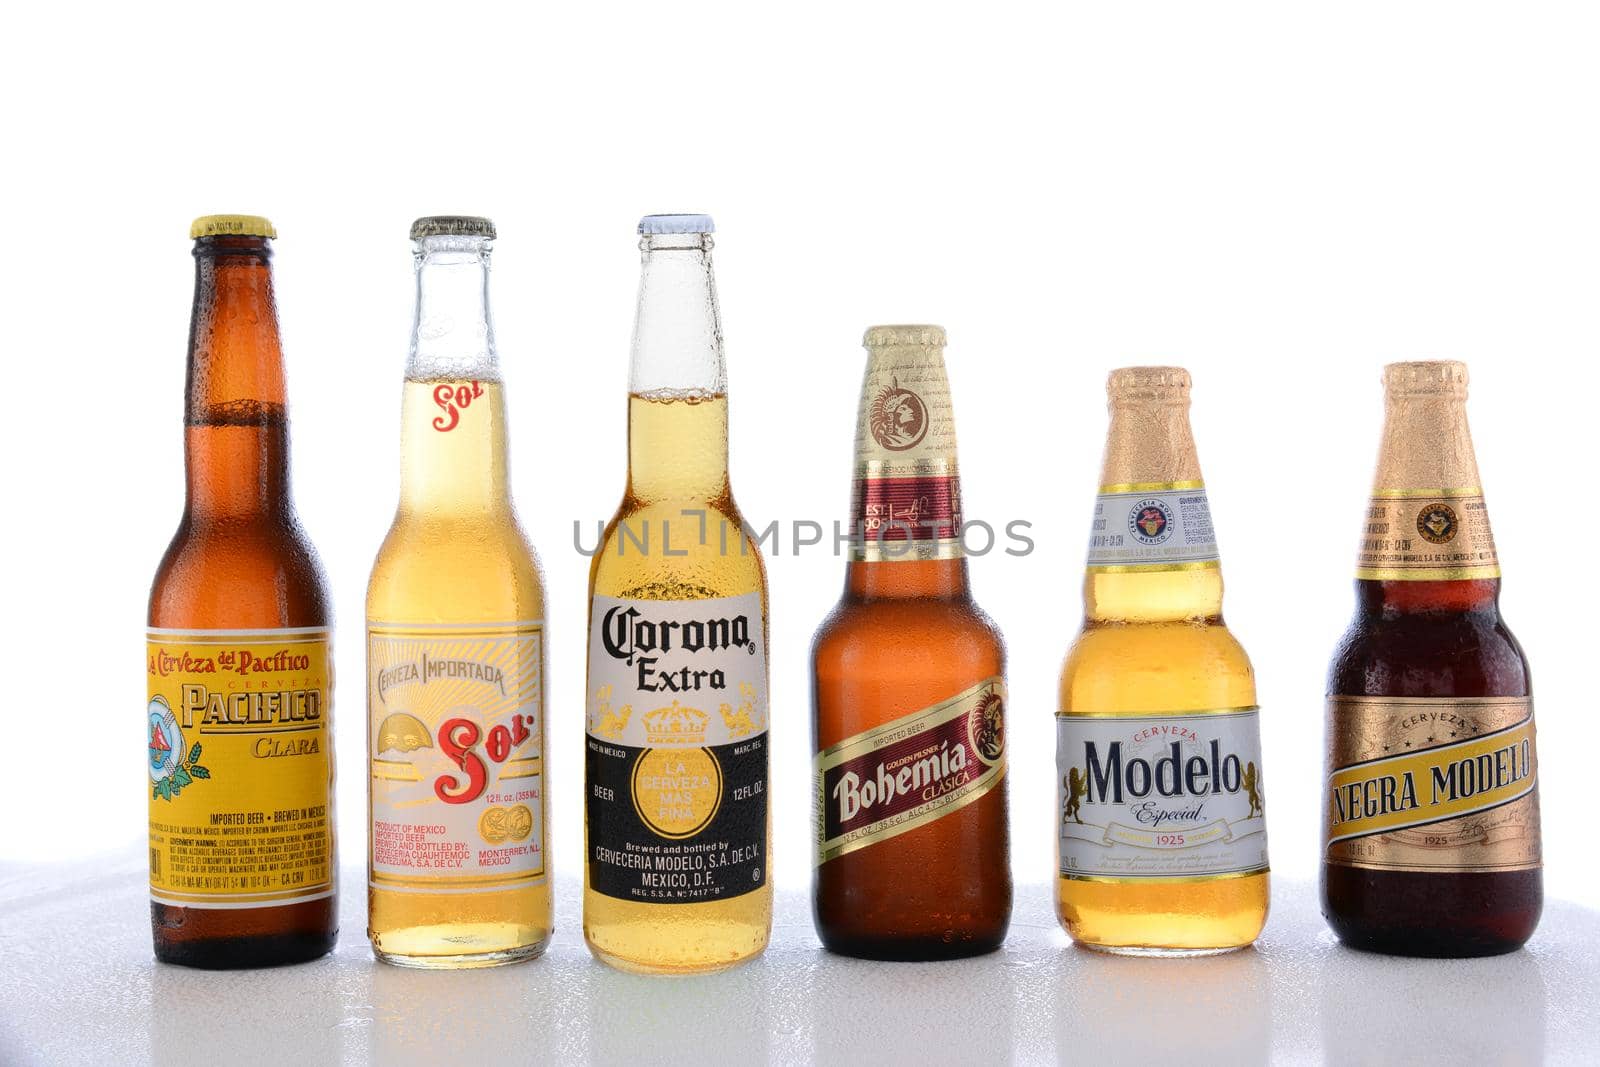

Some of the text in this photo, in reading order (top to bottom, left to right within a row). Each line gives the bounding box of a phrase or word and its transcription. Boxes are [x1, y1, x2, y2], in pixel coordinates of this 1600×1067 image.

[602, 606, 750, 666] Corona
[158, 648, 216, 677] Cerveza
[218, 650, 235, 670] del
[378, 653, 506, 704] CERVEZA IMPORTADA
[636, 656, 726, 692] Extra
[182, 684, 322, 728] PACIFICO
[1402, 712, 1466, 728] CERVEZA
[873, 722, 925, 749] IMPORTED BEER
[1134, 726, 1197, 744] CERVEZA
[253, 736, 320, 758] CLARA
[605, 745, 626, 758] MEXICO
[734, 743, 751, 755] MARC.
[886, 744, 939, 771] GOLDEN PILSNER
[666, 762, 685, 774] LA
[1084, 739, 1241, 804] Modelo
[642, 776, 710, 790] CERVEZA
[1333, 772, 1420, 825] NEGRA
[1430, 738, 1530, 805] MODELO
[594, 784, 614, 801] BEER
[659, 792, 693, 804] MAS
[659, 808, 693, 820] FINA
[908, 807, 925, 819] ALC
[944, 794, 954, 803] BY
[210, 813, 244, 826] IMPORTED
[248, 812, 264, 824] BEER
[274, 810, 300, 822] BREWED
[1130, 801, 1202, 828] Especial
[375, 821, 446, 834] PRODUCT OF MEXICO
[406, 833, 425, 842] BEER
[1156, 835, 1185, 845] 1925
[1424, 836, 1448, 845] 1925
[399, 841, 414, 851] AND
[416, 842, 452, 851] BOTTLED
[455, 842, 468, 851] BY:
[479, 845, 528, 859] MONTERREY,
[626, 841, 729, 854] Brewed and bottled by
[412, 851, 470, 859] CUAUHTEMOC
[479, 857, 510, 866] MEXICO
[596, 844, 759, 872] CERVECERIA MODELO, S.A. DE C.V.
[416, 860, 432, 868] S.A.
[447, 860, 463, 868] C.V.
[282, 874, 290, 885] CA
[642, 871, 715, 888] MEXICO, D.F.
[632, 888, 649, 896] REG.
[651, 889, 675, 898] S.S.A.
[688, 889, 707, 897] 7417
